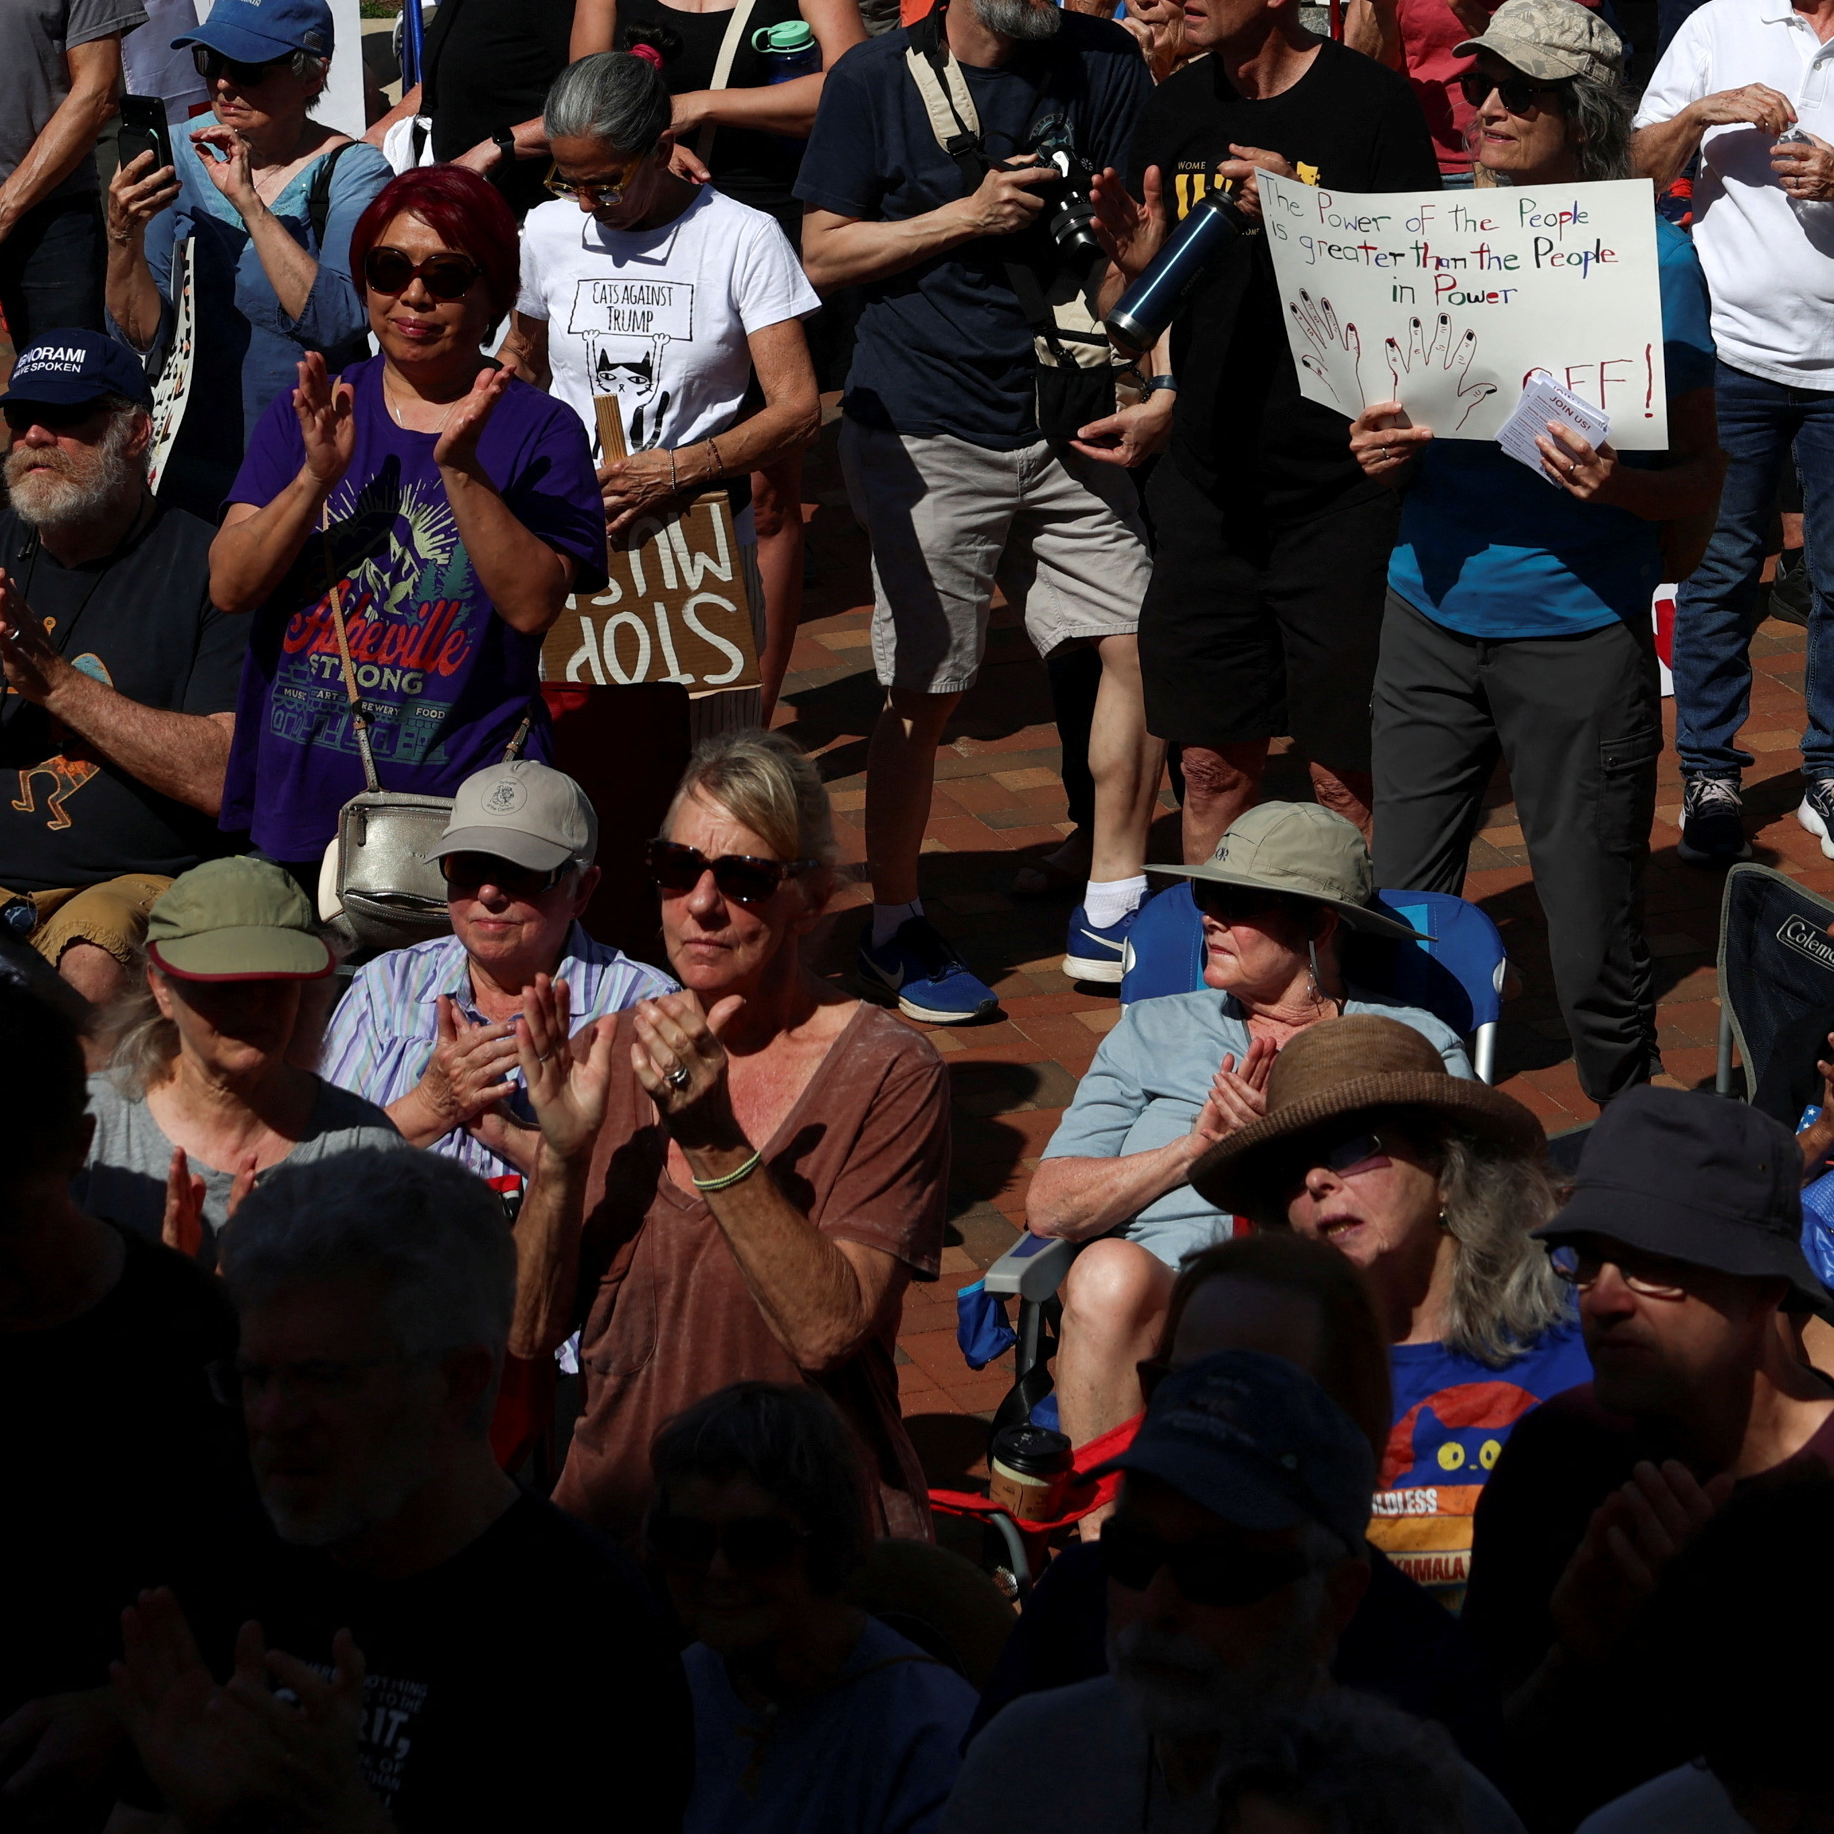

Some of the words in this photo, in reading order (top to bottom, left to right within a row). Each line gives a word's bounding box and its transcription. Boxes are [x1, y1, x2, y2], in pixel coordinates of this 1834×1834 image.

[593, 282, 619, 304] CATS
[621, 284, 673, 306] AGAINST
[607, 306, 653, 332] TRUMP
